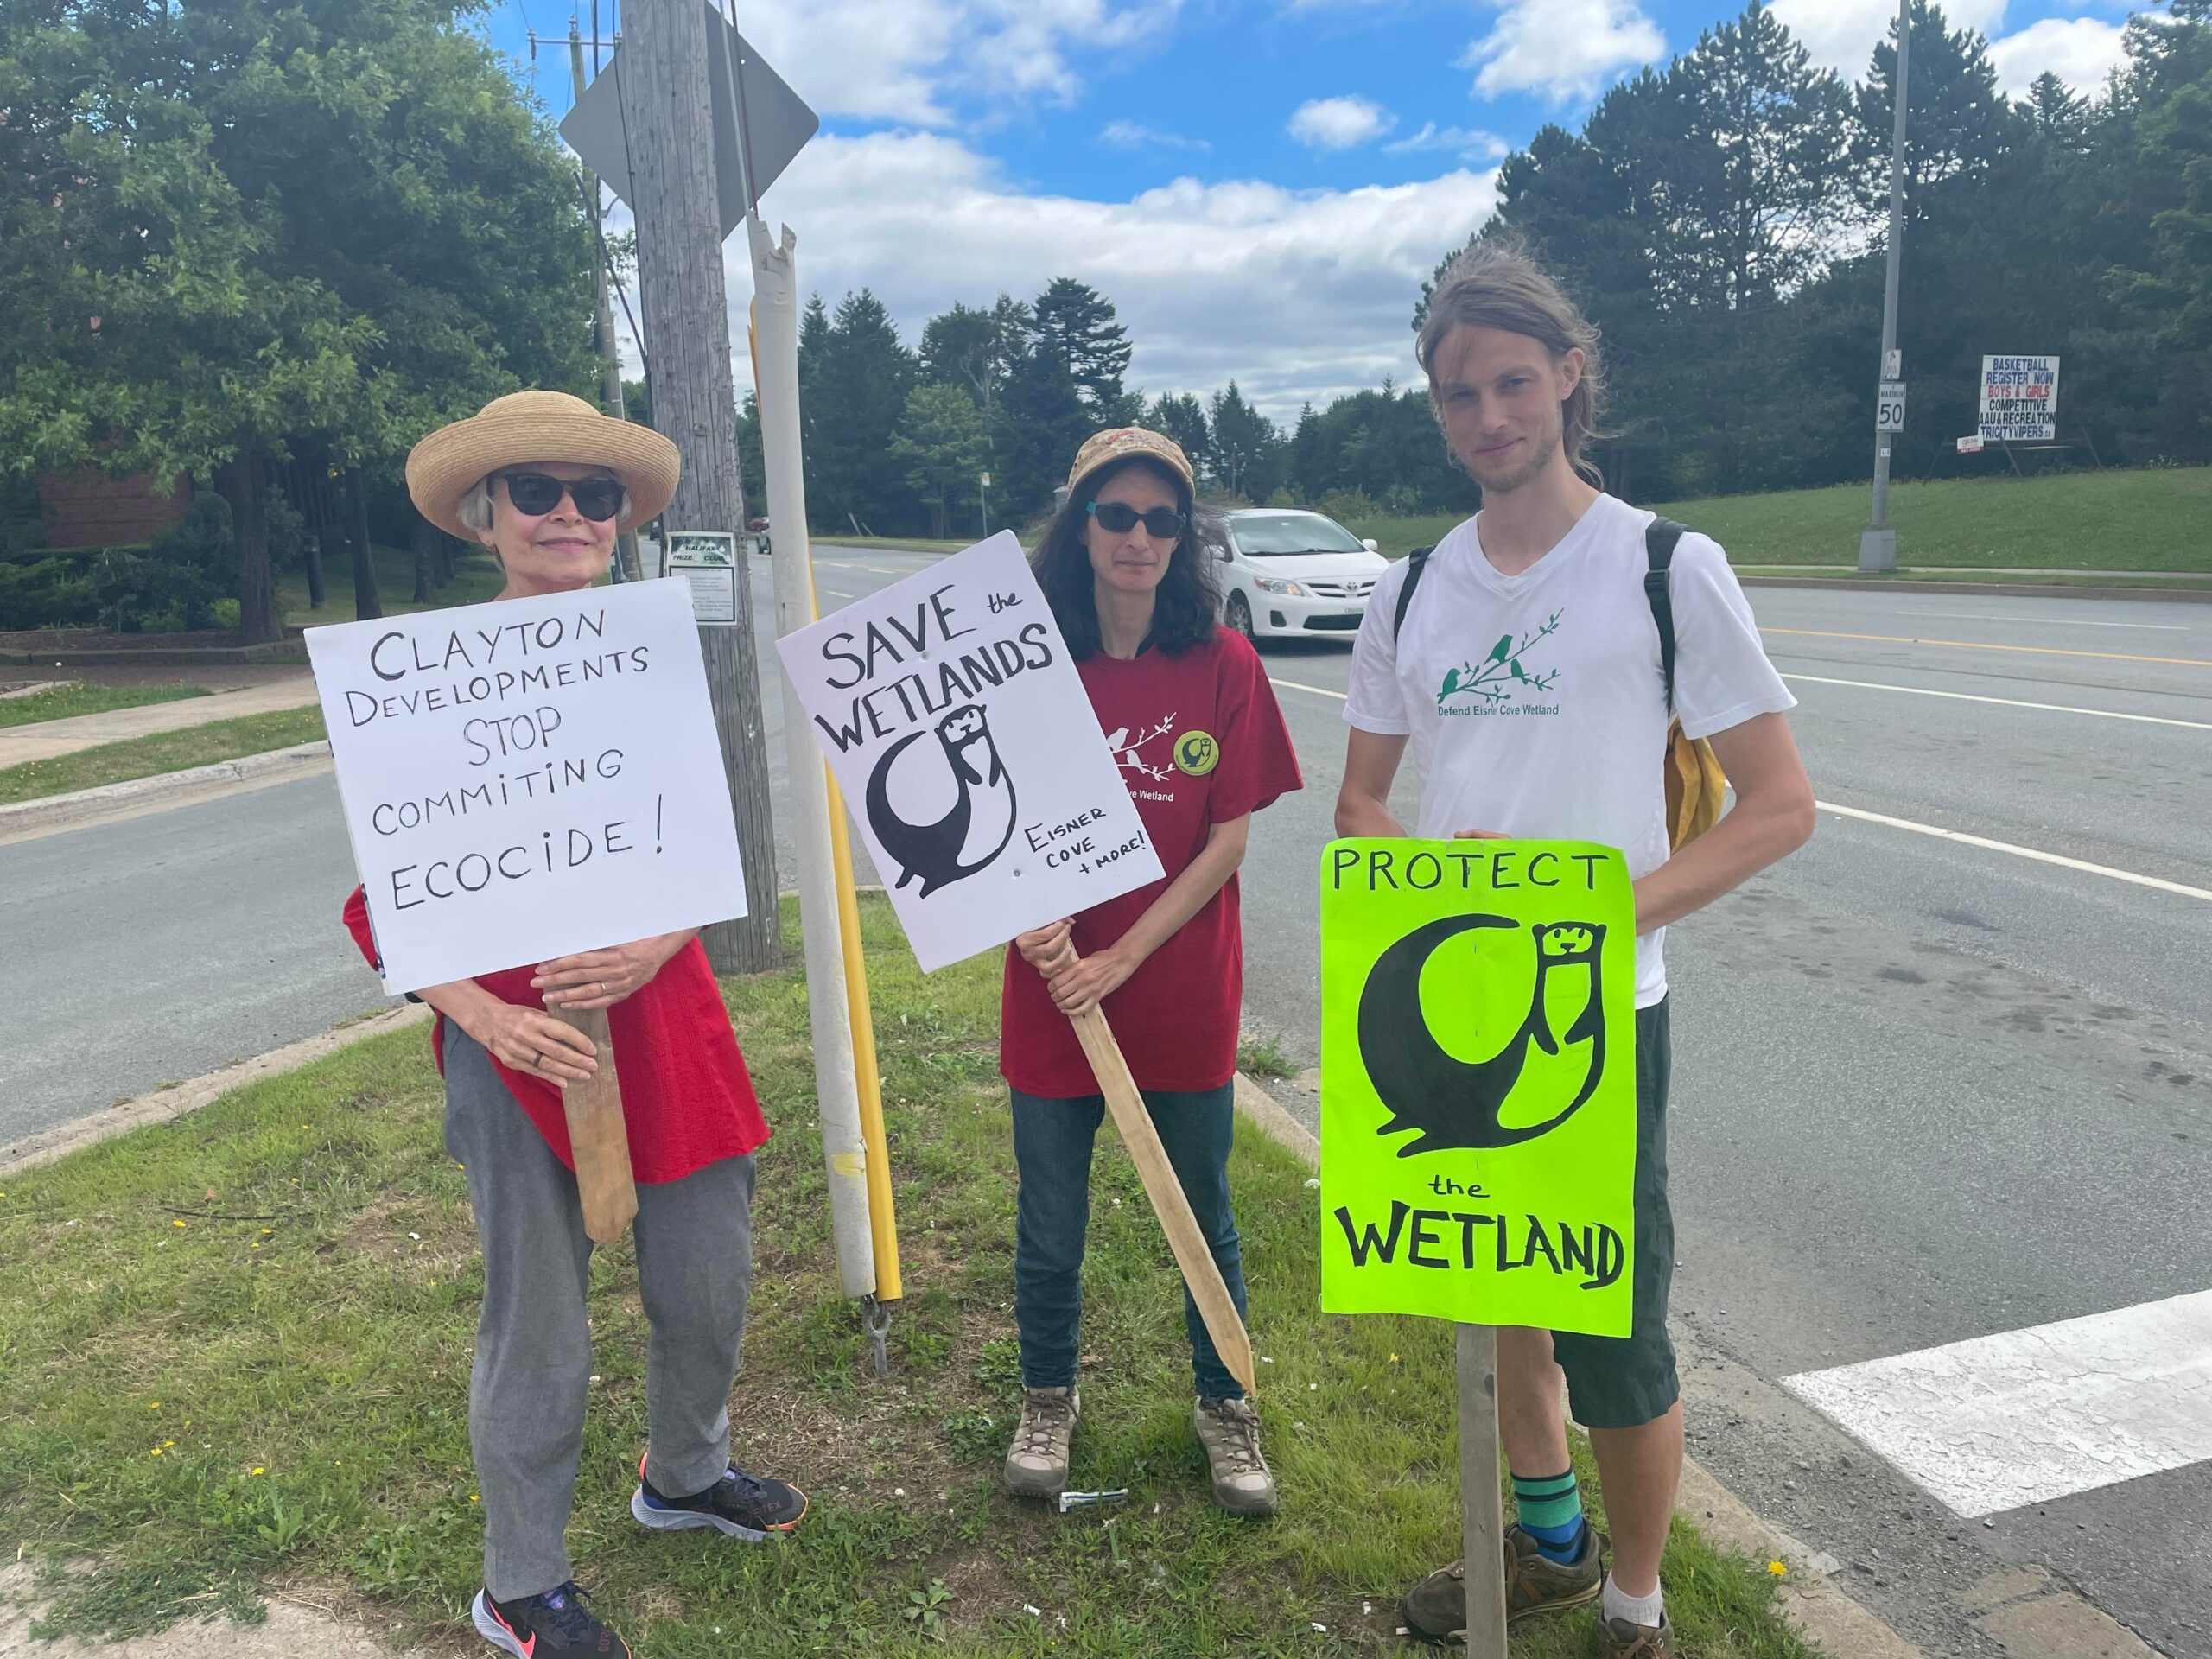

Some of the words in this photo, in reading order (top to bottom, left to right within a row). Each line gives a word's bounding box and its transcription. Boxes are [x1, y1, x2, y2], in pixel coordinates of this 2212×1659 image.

[1986, 372, 2028, 385] REGISTER
[2034, 372, 2054, 385] NOW
[1993, 358, 2049, 371] BASKETBALL
[1988, 385, 2011, 397] BOYS
[2015, 385, 2020, 397] &
[2026, 385, 2050, 397] GIRLS
[1989, 398, 2047, 411] COMPETITIVE
[1879, 404, 1903, 424] 50
[370, 609, 605, 681] CLAYTON
[823, 585, 977, 690] SAVE
[988, 594, 1023, 614] the
[344, 646, 650, 728] DEVELOPMENTS
[815, 624, 1052, 753] WETLANDS
[1438, 706, 1470, 716] Defend
[1500, 705, 1520, 715] Cove
[1522, 704, 1559, 715] Wetland
[463, 706, 562, 766] STOP
[1139, 789, 1174, 802] Wetland
[1025, 808, 1106, 853] EISNER
[1046, 836, 1096, 868] COVE
[1096, 830, 1146, 868] MORE!
[1334, 849, 1610, 891] PROTECT
[1427, 1174, 1491, 1198] the
[1333, 1200, 1624, 1291] WETLAND
